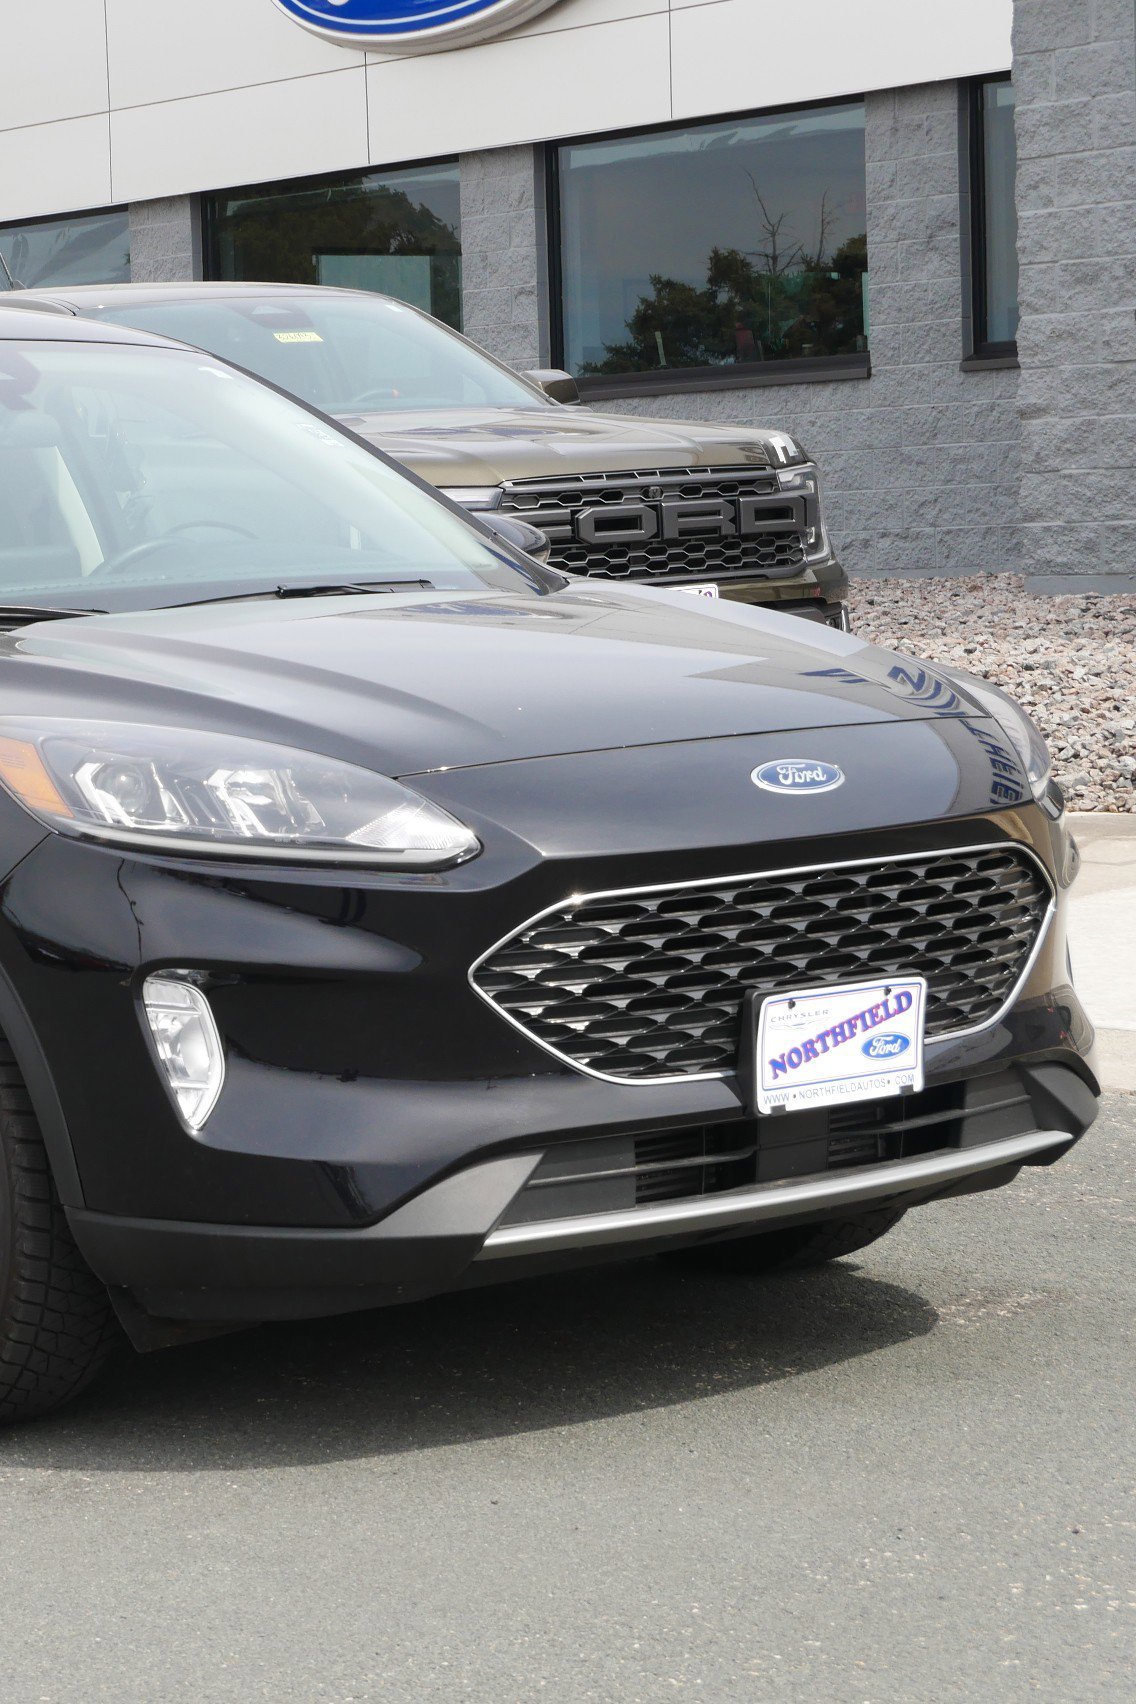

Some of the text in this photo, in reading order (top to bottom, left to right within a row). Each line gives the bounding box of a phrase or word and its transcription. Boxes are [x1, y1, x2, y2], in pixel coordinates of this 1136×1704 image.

[776, 763, 827, 785] Ford
[770, 1008, 830, 1023] CHRYSLER
[768, 990, 913, 1080] NORTHFIELD
[869, 1035, 901, 1055] Ford
